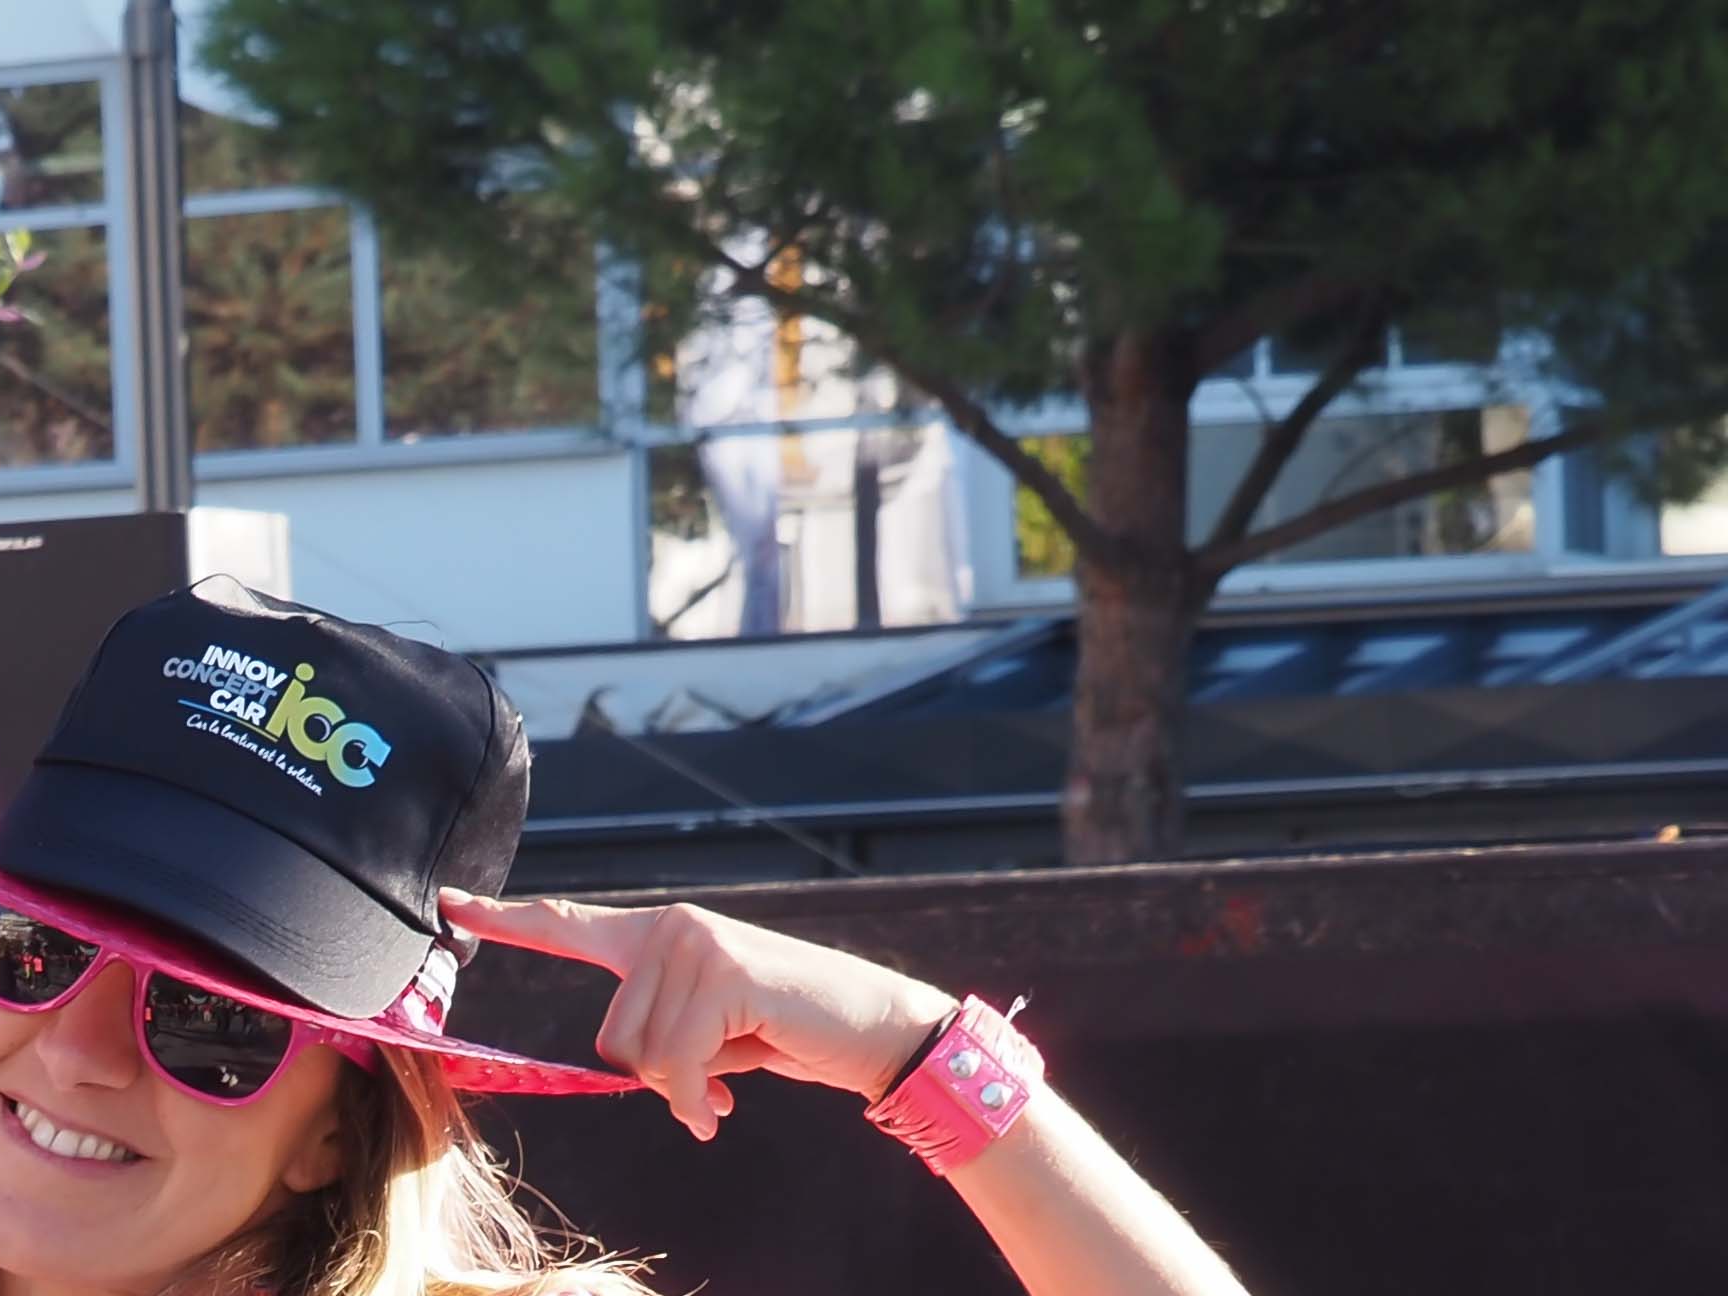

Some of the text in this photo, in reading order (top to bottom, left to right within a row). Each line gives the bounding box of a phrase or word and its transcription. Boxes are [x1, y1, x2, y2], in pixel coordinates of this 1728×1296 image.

[163, 657, 277, 705] CONCEPT
[201, 645, 288, 688] INNOV
[209, 689, 267, 726] CAR
[208, 719, 220, 735] la
[220, 724, 258, 753] location
[258, 748, 277, 762] est
[275, 754, 287, 771] la
[286, 765, 324, 797] solution
